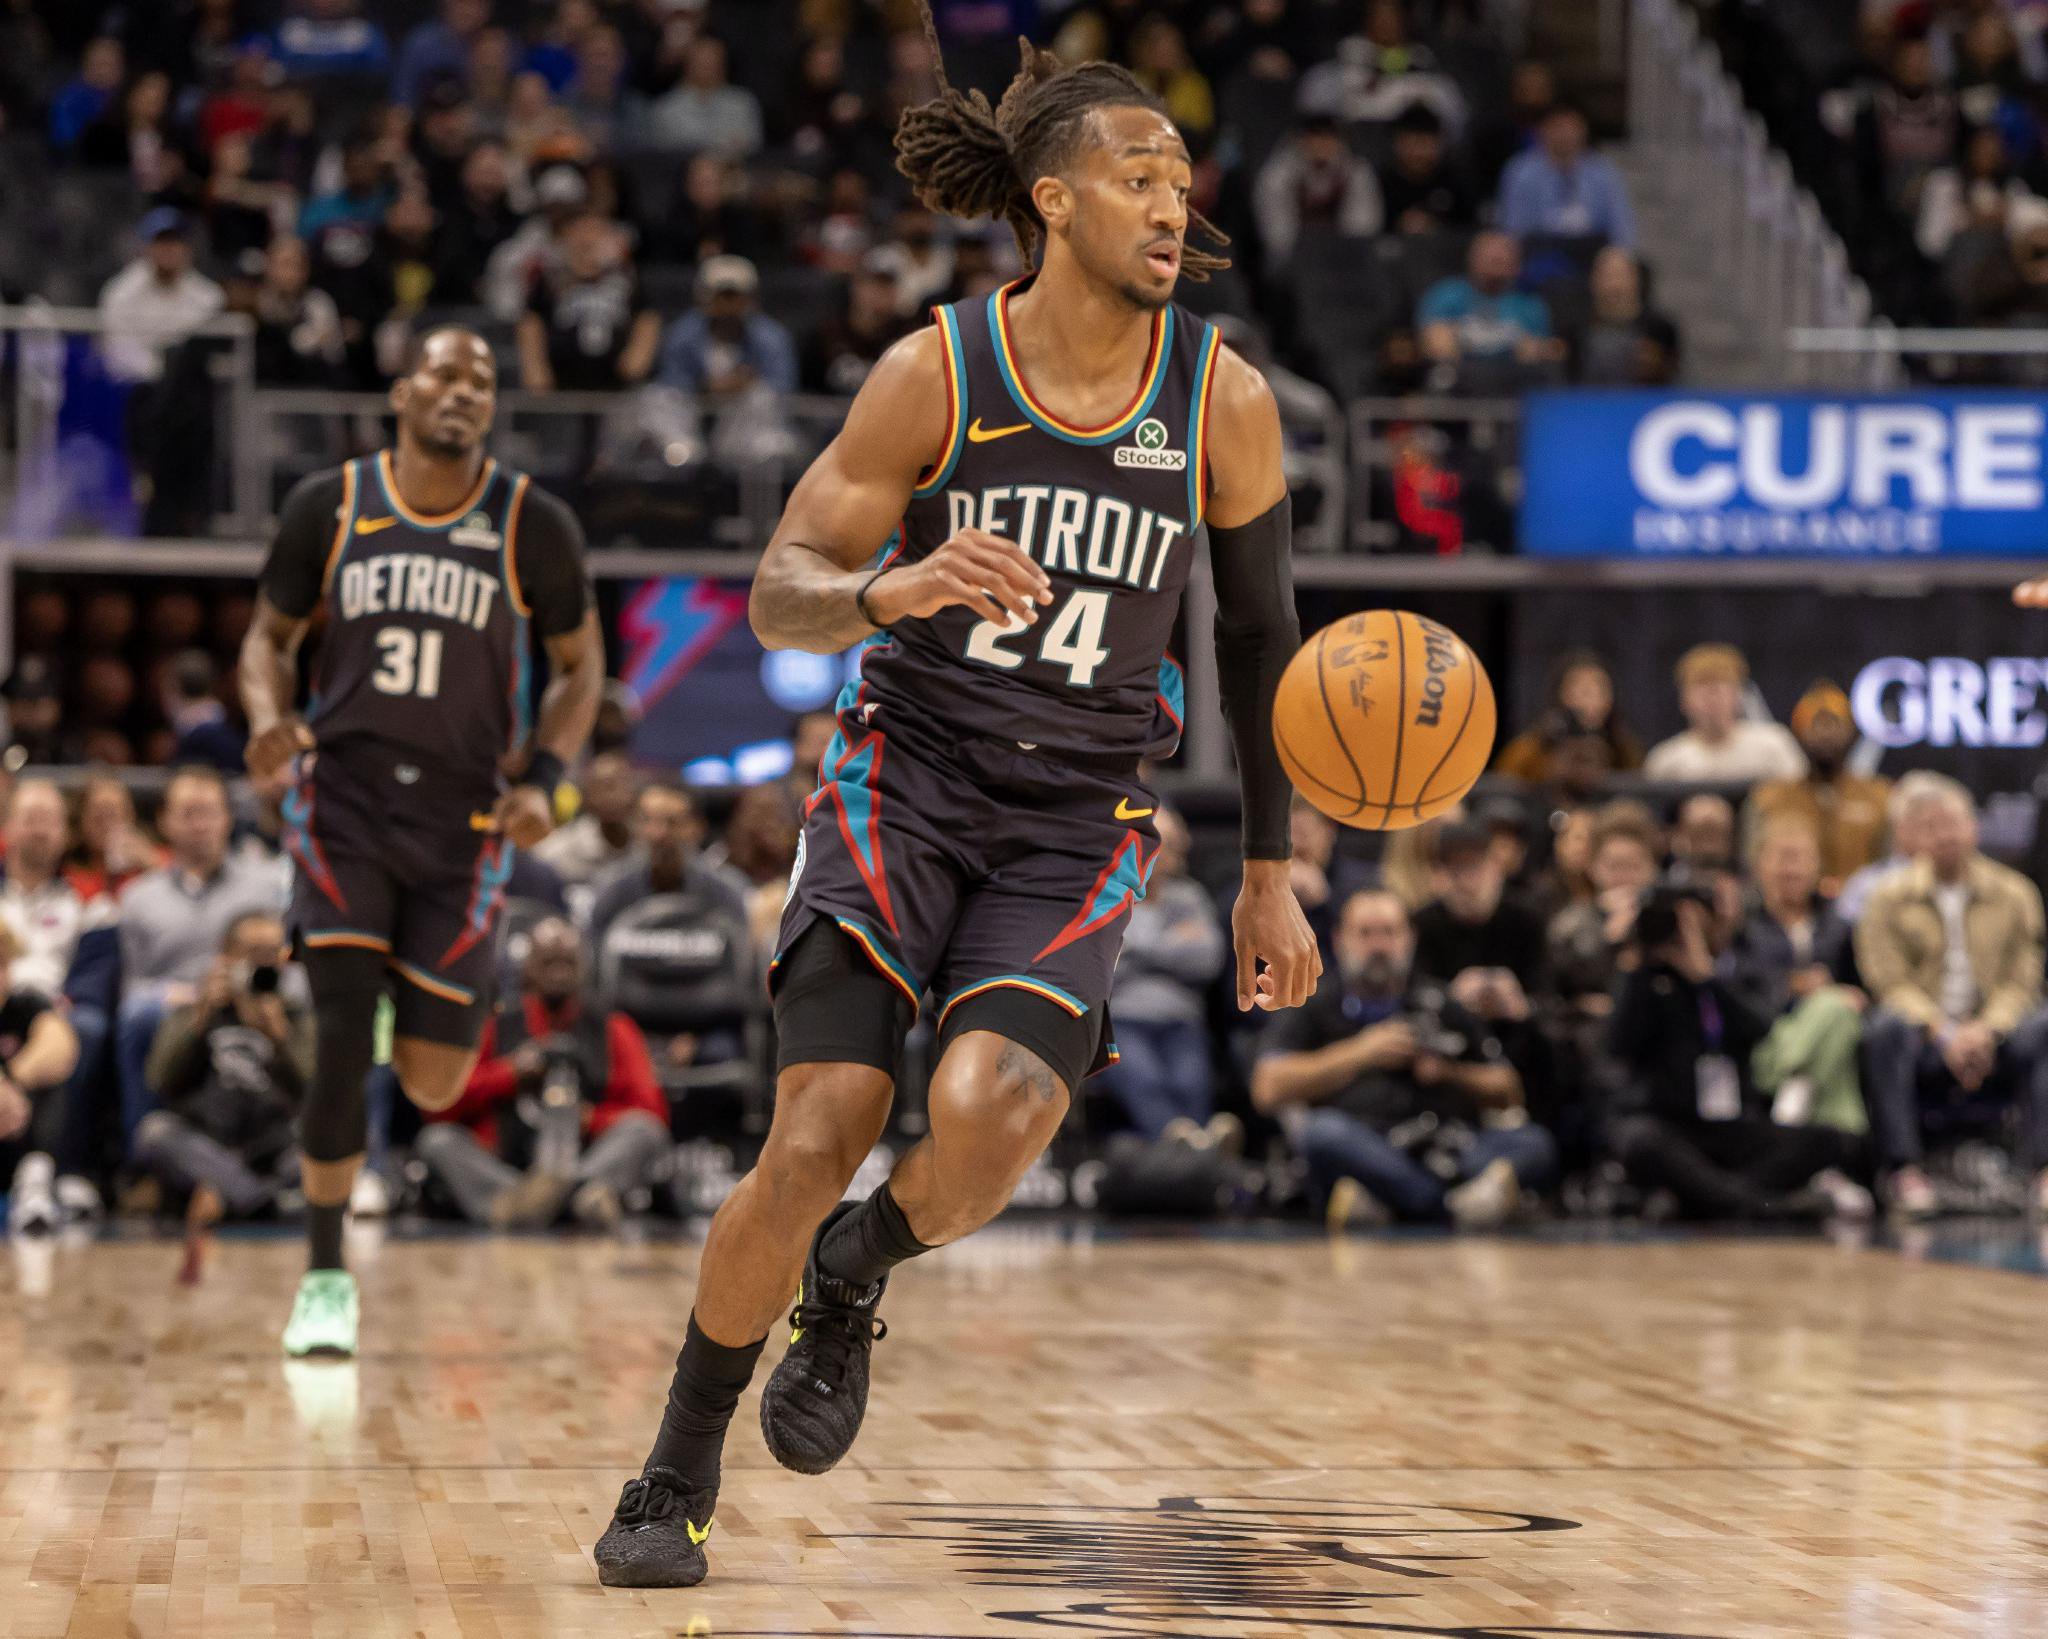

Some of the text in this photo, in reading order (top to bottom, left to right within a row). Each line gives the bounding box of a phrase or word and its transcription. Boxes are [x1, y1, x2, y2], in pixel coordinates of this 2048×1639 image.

[1117, 449, 1184, 467] StockX
[1629, 400, 2045, 509] CURE
[948, 484, 1185, 592] DETROIT
[1632, 507, 1943, 553] INSURANCE
[341, 553, 500, 631] DETROIT
[372, 625, 445, 699] 31
[963, 587, 1112, 689] 24
[1851, 655, 2048, 748] GRE
